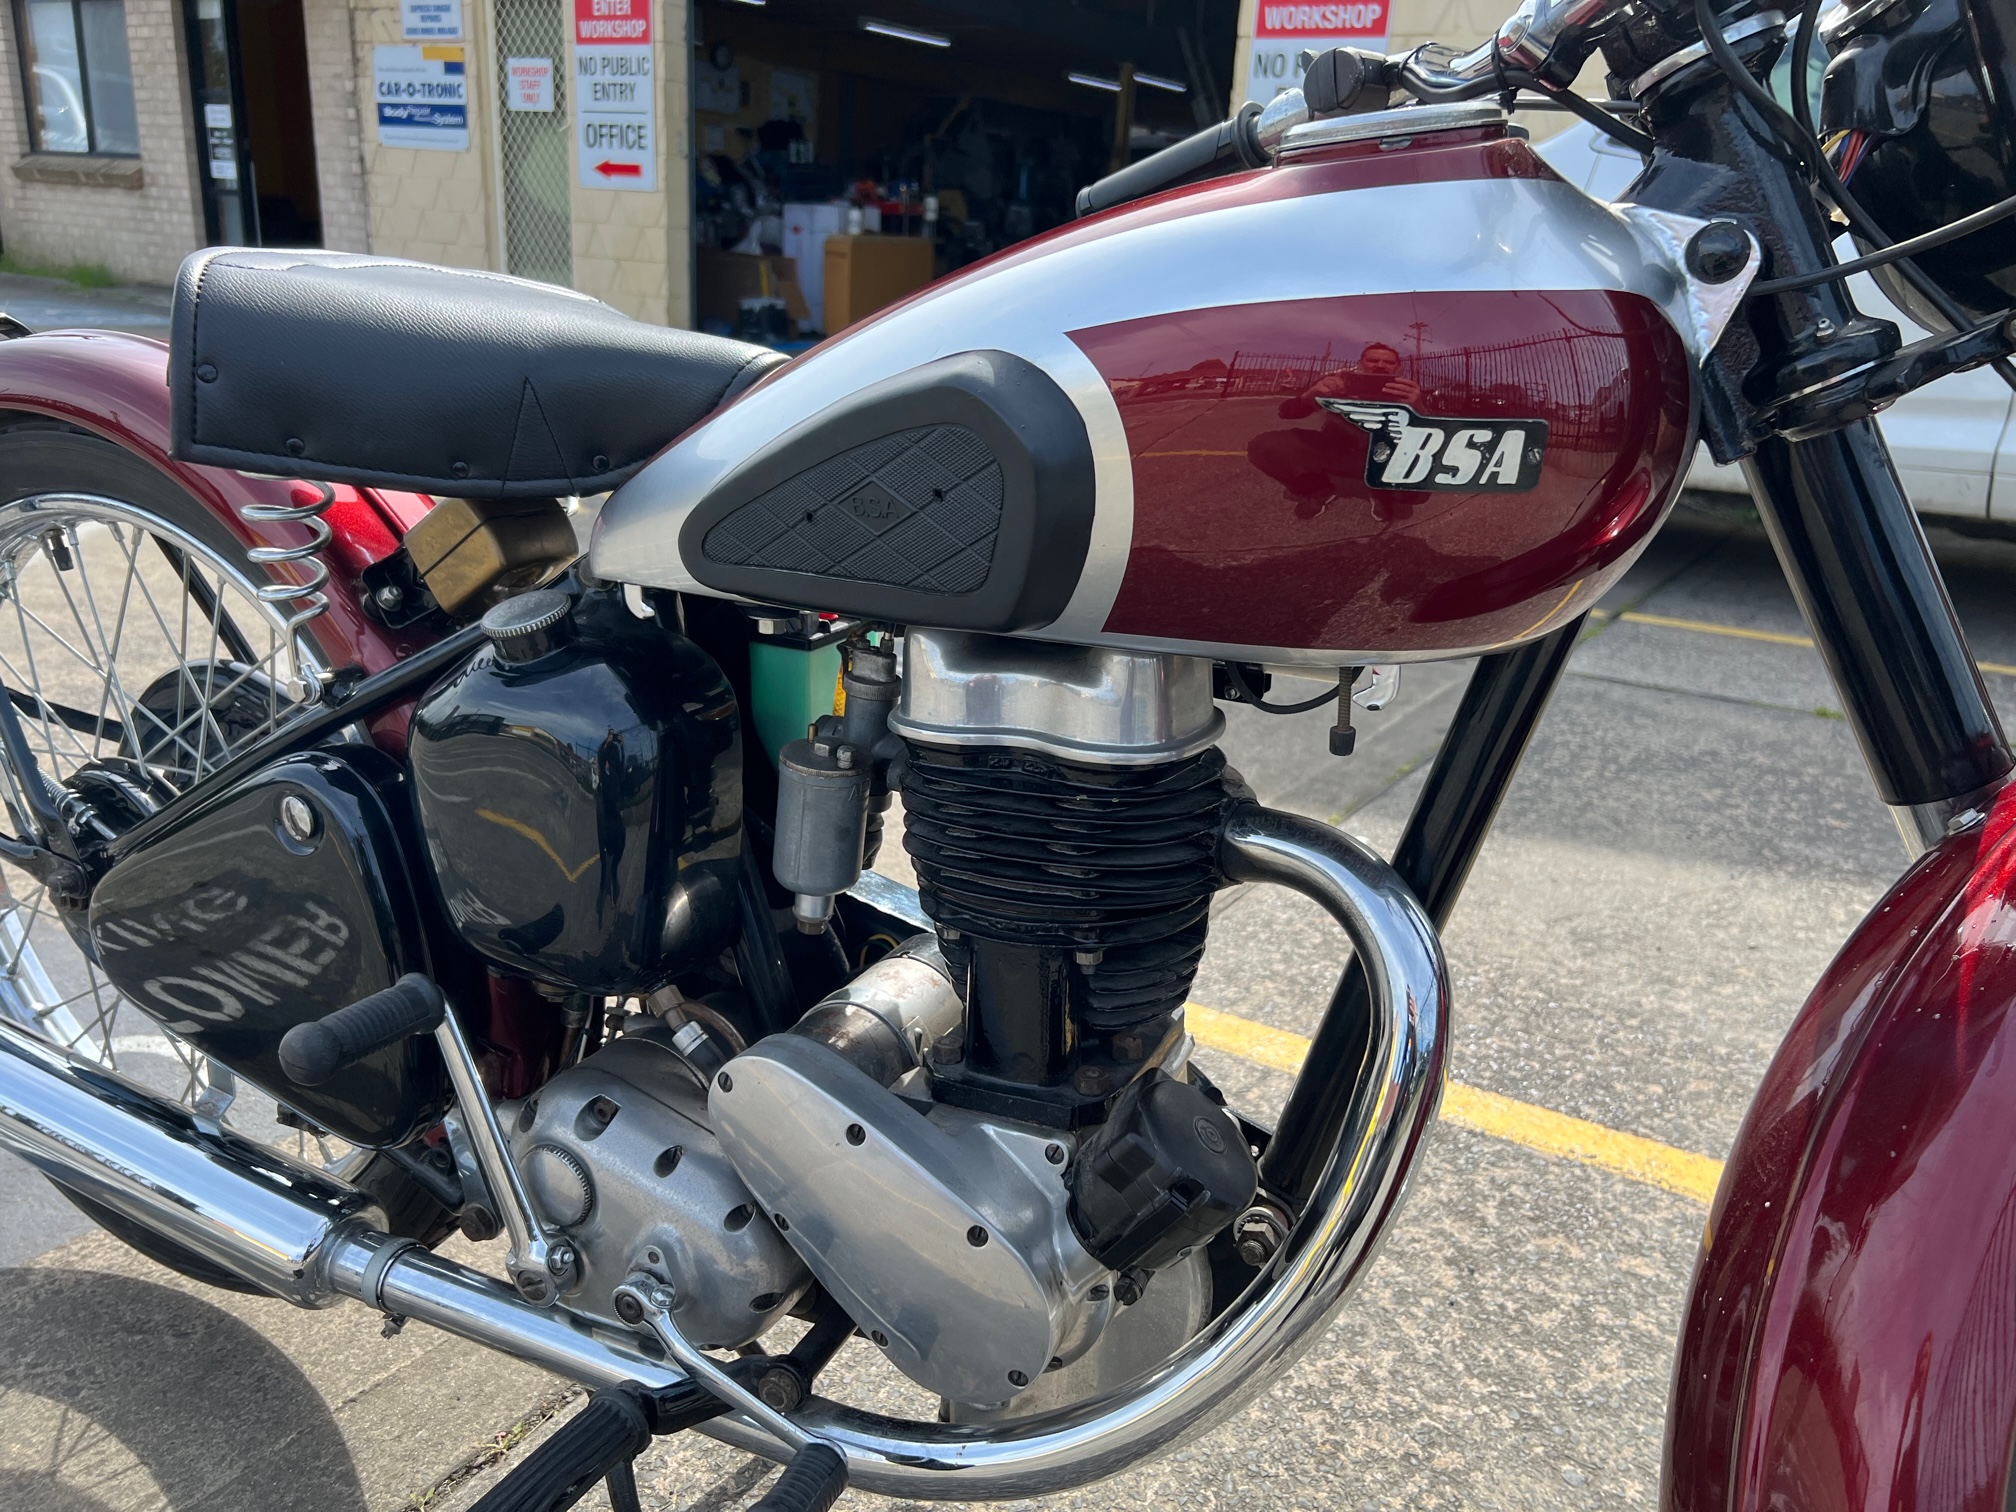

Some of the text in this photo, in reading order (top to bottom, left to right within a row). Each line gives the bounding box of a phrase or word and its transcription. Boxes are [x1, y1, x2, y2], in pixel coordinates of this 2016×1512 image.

[592, 0, 631, 16] ENTER
[1264, 4, 1382, 30] WORKSHOP
[579, 19, 646, 38] WORKSHOP
[511, 66, 549, 77] WORKSHOP
[578, 56, 650, 77] NO PUBLIC
[1254, 53, 1286, 78] NO
[378, 81, 464, 99] CAR-O-TRONIC
[593, 82, 636, 102] ENTRY
[585, 123, 649, 150] OFFICE
[1381, 426, 1526, 486] BSA
